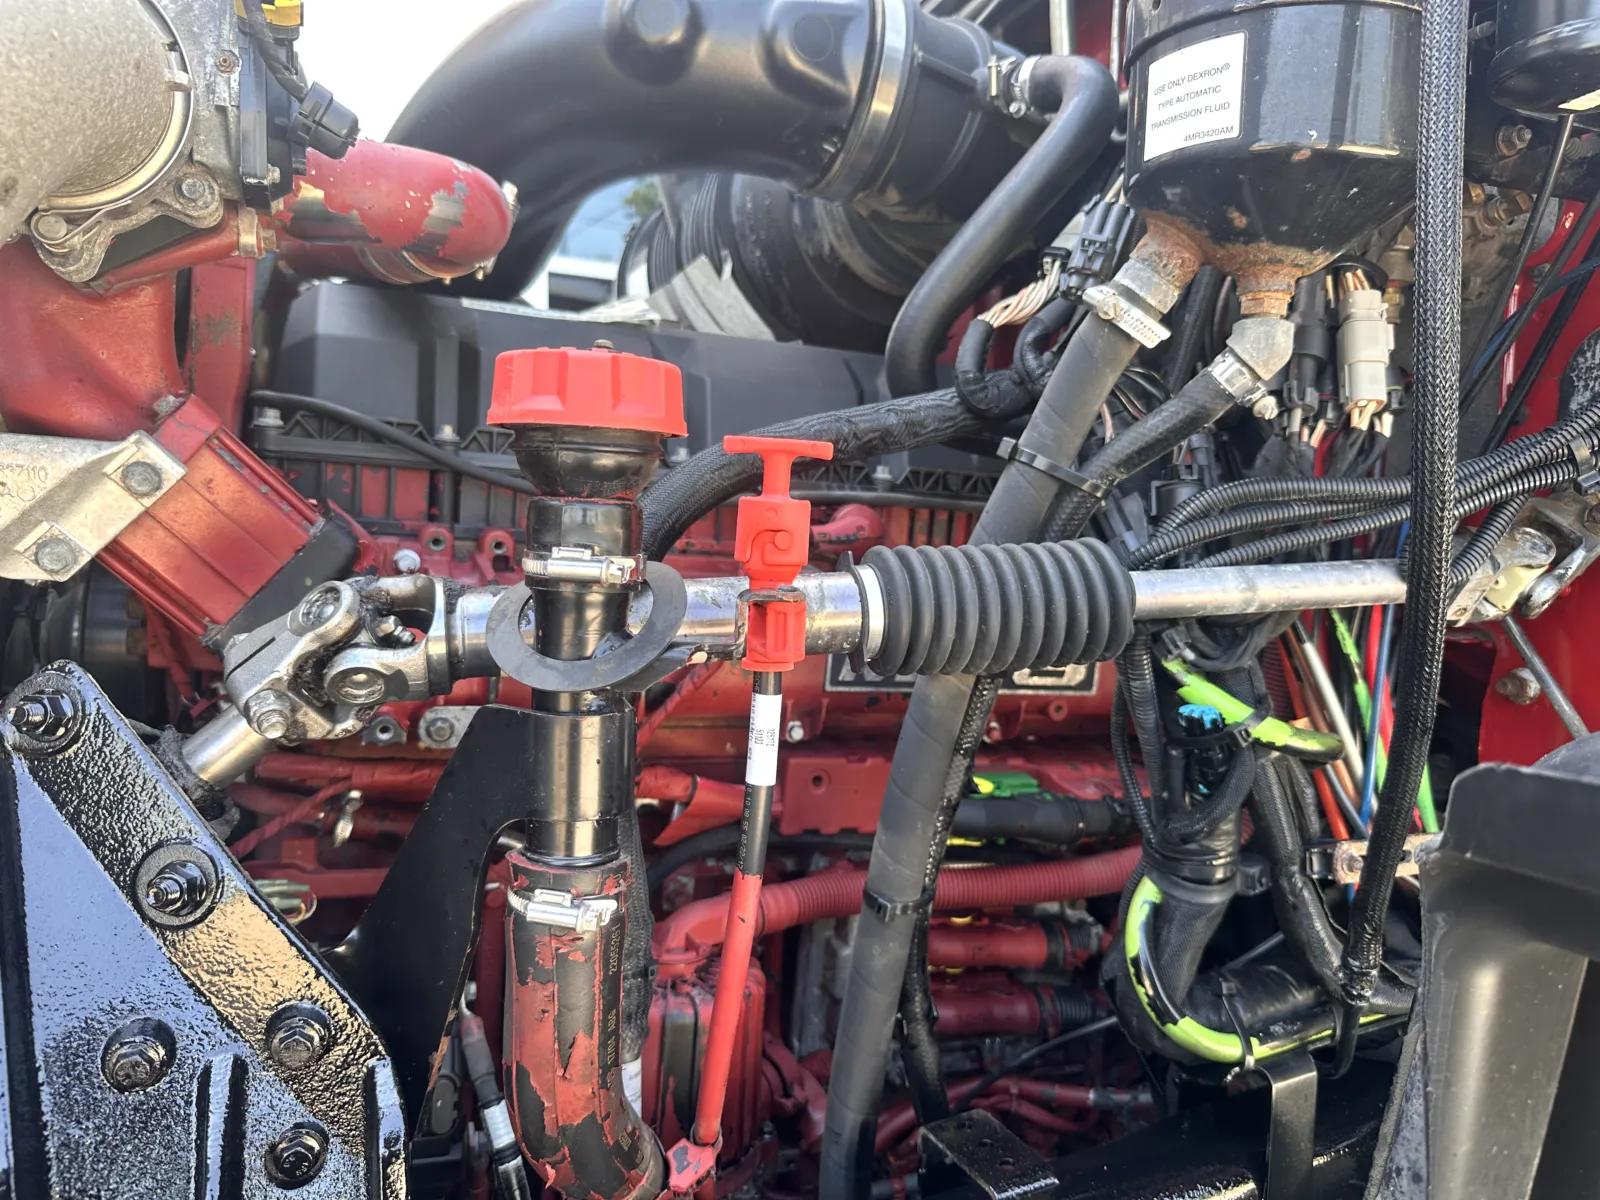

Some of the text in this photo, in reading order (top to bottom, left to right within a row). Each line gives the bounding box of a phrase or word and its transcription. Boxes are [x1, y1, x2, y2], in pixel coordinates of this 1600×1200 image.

[1153, 84, 1167, 96] USE
[1167, 76, 1186, 90] ONLY
[1158, 85, 1222, 111] TYPE AUTOMATIC
[1151, 101, 1231, 132] TRANSMISSION FLUID
